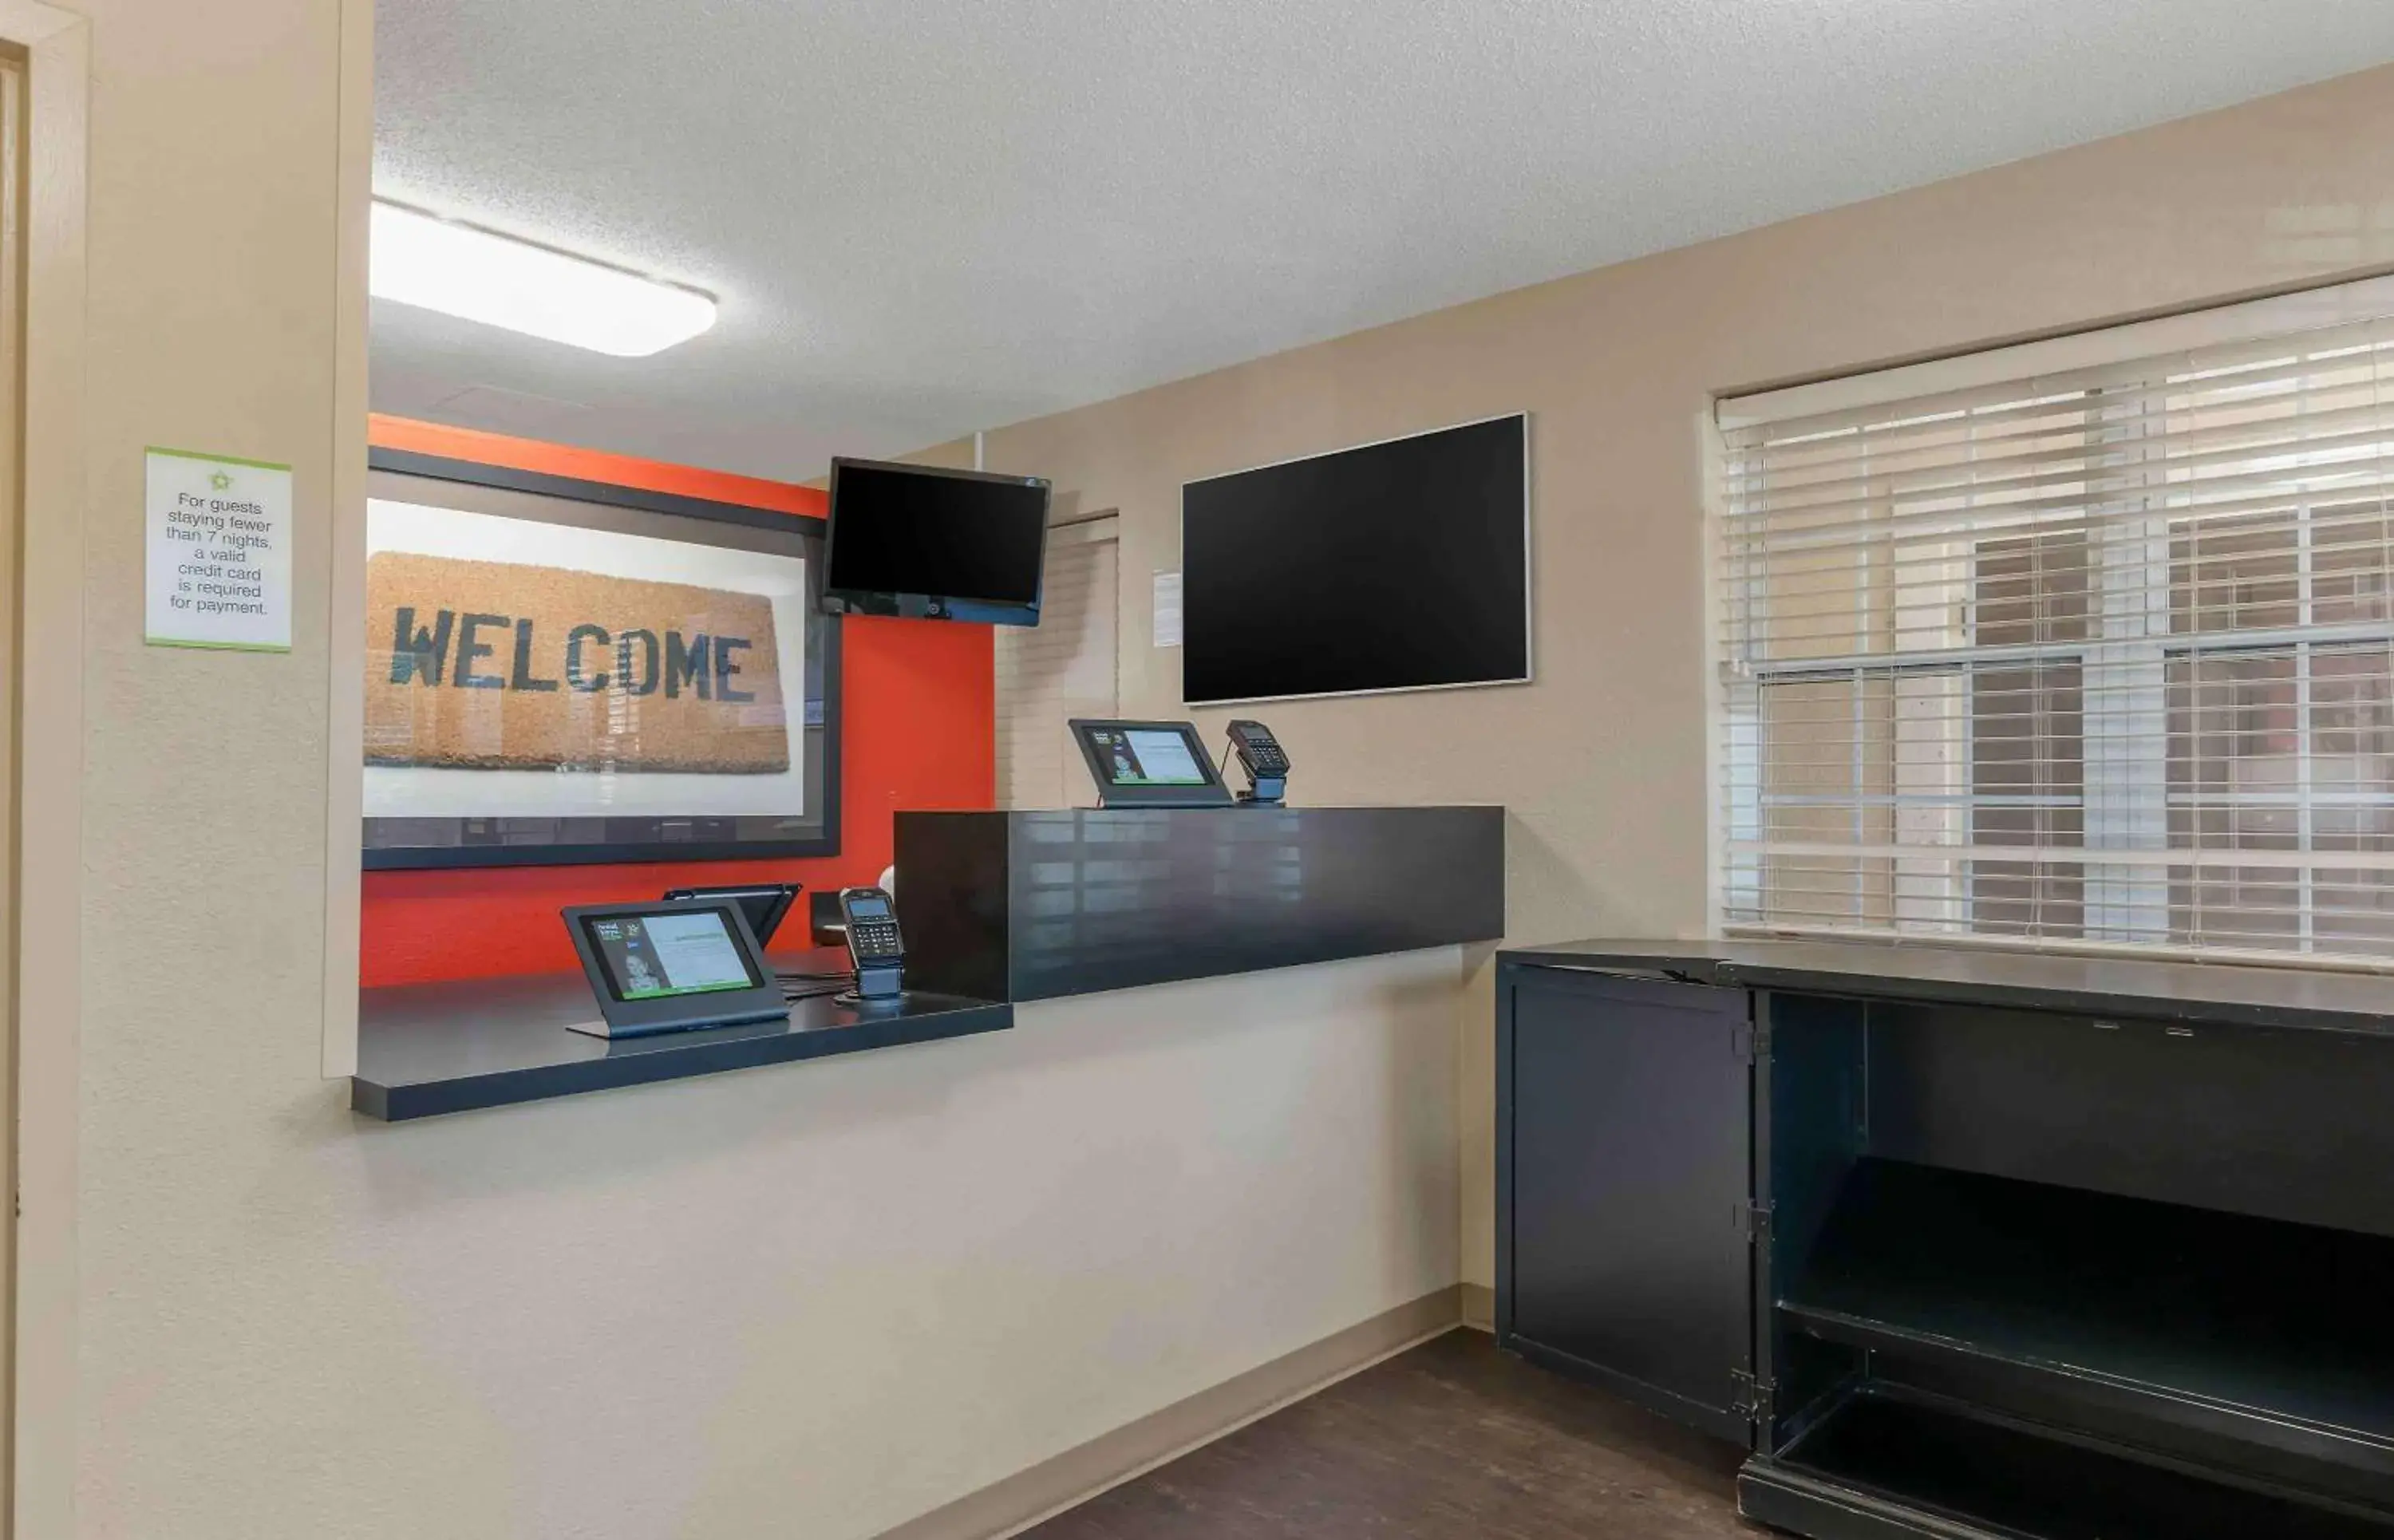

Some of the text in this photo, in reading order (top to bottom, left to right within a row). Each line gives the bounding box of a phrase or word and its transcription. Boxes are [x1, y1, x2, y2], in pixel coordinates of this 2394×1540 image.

[178, 492, 263, 515] For guests
[168, 511, 271, 532] staying fewer
[166, 527, 272, 550] than 7 nights,
[194, 548, 246, 563] a valid
[178, 564, 261, 581] credit card
[178, 578, 261, 598] is required
[170, 595, 268, 615] for payment.
[390, 606, 756, 702] WELCOME
